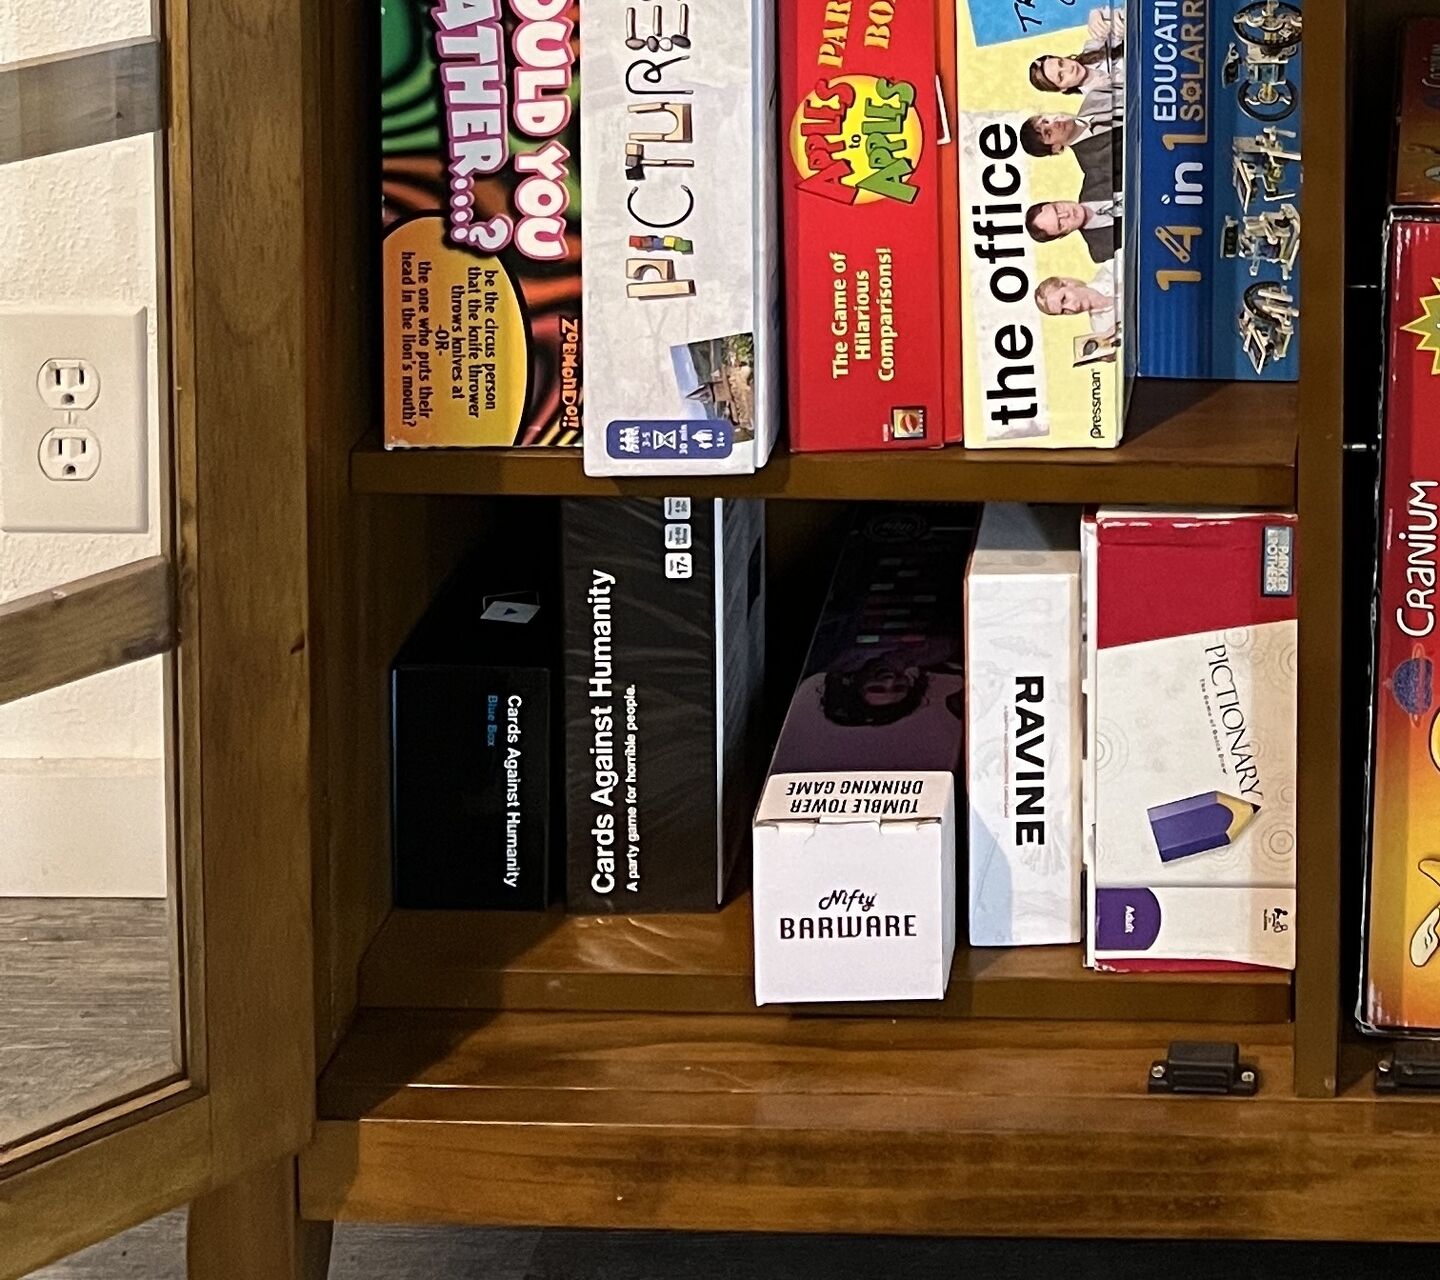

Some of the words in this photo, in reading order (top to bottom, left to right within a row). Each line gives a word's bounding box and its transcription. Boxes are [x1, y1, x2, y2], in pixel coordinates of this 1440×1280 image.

[1180, 24, 1205, 122] SOLAR
[796, 78, 858, 205] APPLES
[848, 134, 861, 150] to
[855, 77, 919, 204] APPLES
[515, 140, 570, 261] YOU
[1161, 161, 1204, 205] in
[972, 123, 1029, 303] office
[402, 251, 415, 286] head
[418, 261, 432, 284] the
[829, 252, 848, 274] of
[1155, 224, 1203, 292] 14
[468, 266, 482, 288] that
[485, 269, 499, 287] be
[402, 290, 415, 303] in
[418, 288, 429, 313] one
[451, 285, 465, 333] throws
[468, 296, 482, 321] the
[485, 291, 499, 314] the
[831, 281, 848, 339] Game
[855, 269, 871, 360] Hilarious
[878, 247, 893, 382] Comparisons!
[402, 308, 416, 330] the
[418, 317, 432, 347] who
[485, 315, 499, 359] circus
[402, 334, 417, 371] lion's
[435, 325, 449, 356] -OR-
[452, 337, 466, 381] knives
[468, 323, 483, 362] knife
[416, 351, 433, 382] puts
[832, 345, 849, 378] The
[986, 323, 1038, 426] the
[402, 376, 417, 428] mouth?
[419, 385, 433, 419] their
[452, 384, 465, 400] at
[468, 364, 483, 419] thrower
[482, 363, 496, 410] person
[676, 556, 688, 575] 17+
[587, 569, 616, 697] Humanity
[507, 694, 522, 744] Cards
[624, 684, 638, 731] people.
[1204, 644, 1263, 798] PICTIONARY
[589, 705, 619, 807] Against
[624, 733, 637, 783] horrible
[1015, 675, 1045, 846] RAVINE
[504, 746, 522, 808] Against
[625, 785, 637, 804] for
[785, 781, 836, 796] GAME
[840, 780, 924, 795] DRINKING
[627, 806, 640, 842] game
[790, 798, 848, 814] TOWER
[852, 798, 919, 814] TUMBLE
[503, 811, 521, 888] Humanity
[591, 813, 615, 894] Cards
[627, 844, 640, 879] party
[626, 881, 638, 892] A
[818, 889, 878, 912] Nifty
[779, 915, 918, 940] BARWARE
